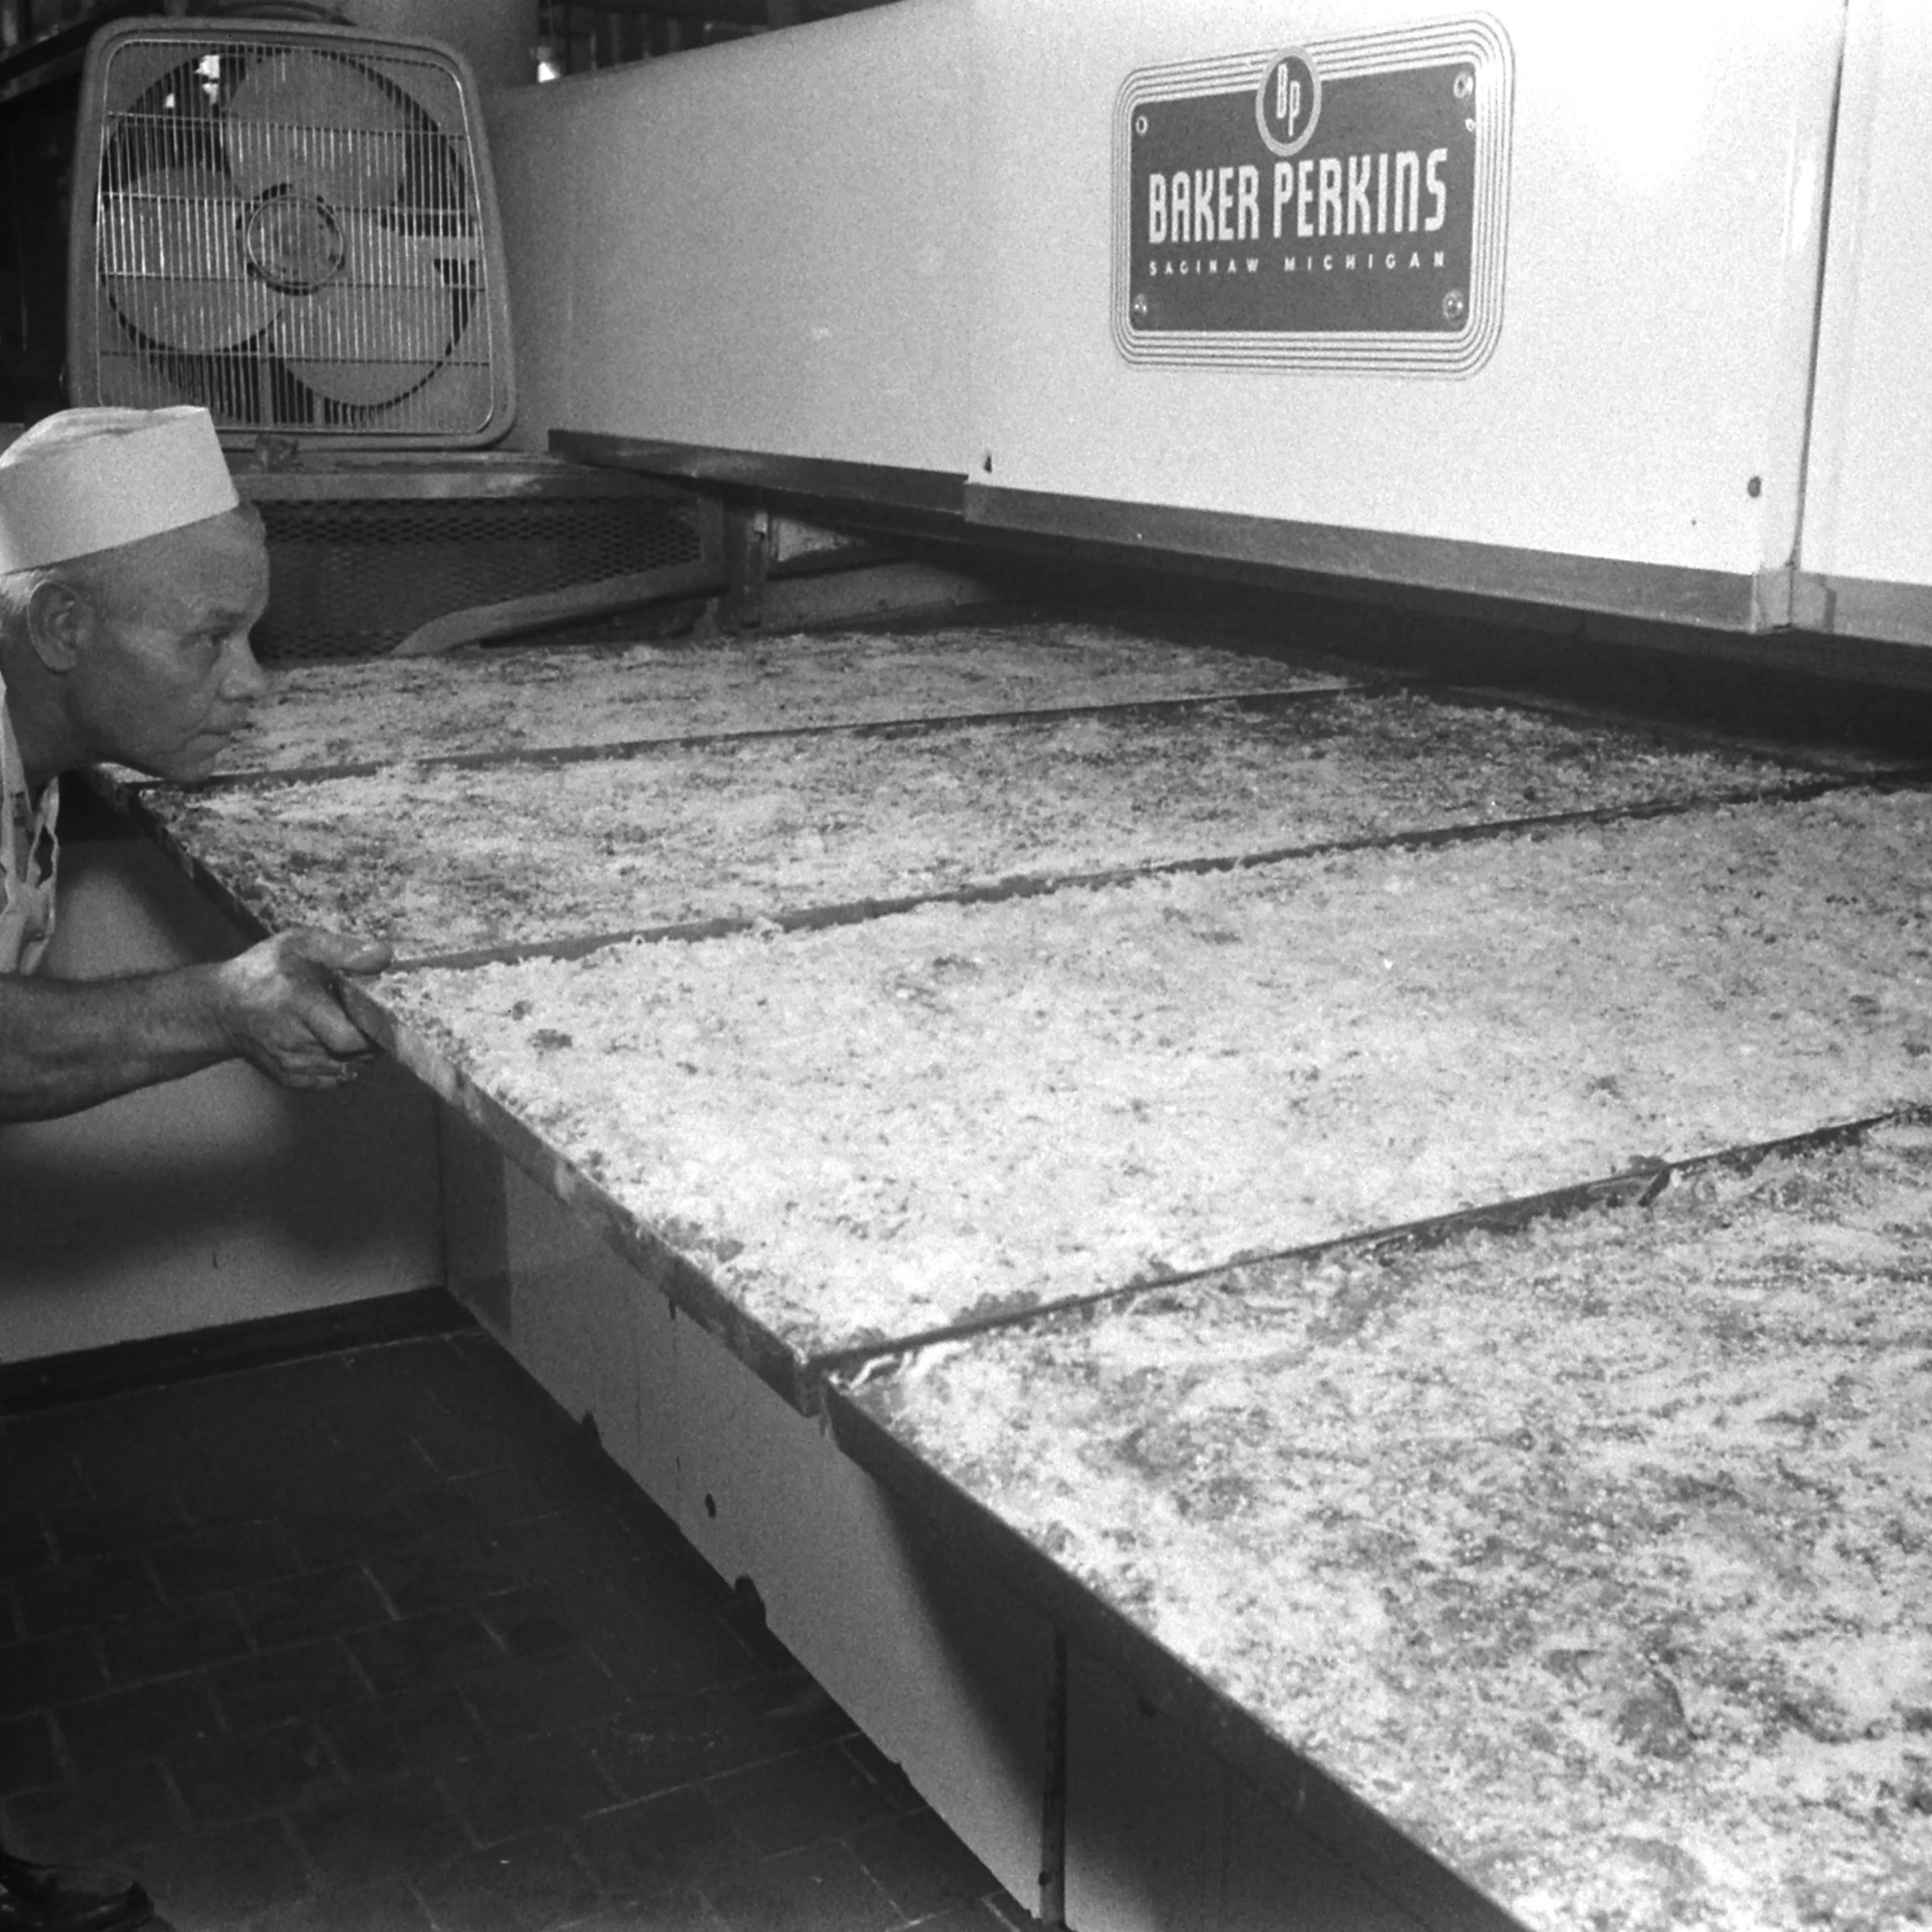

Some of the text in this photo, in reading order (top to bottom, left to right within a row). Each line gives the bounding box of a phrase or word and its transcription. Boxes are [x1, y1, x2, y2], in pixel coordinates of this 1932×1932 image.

[1149, 148, 1448, 244] BAKER PERKINS
[1149, 251, 1445, 276] SAGINAW MICHIGAN
